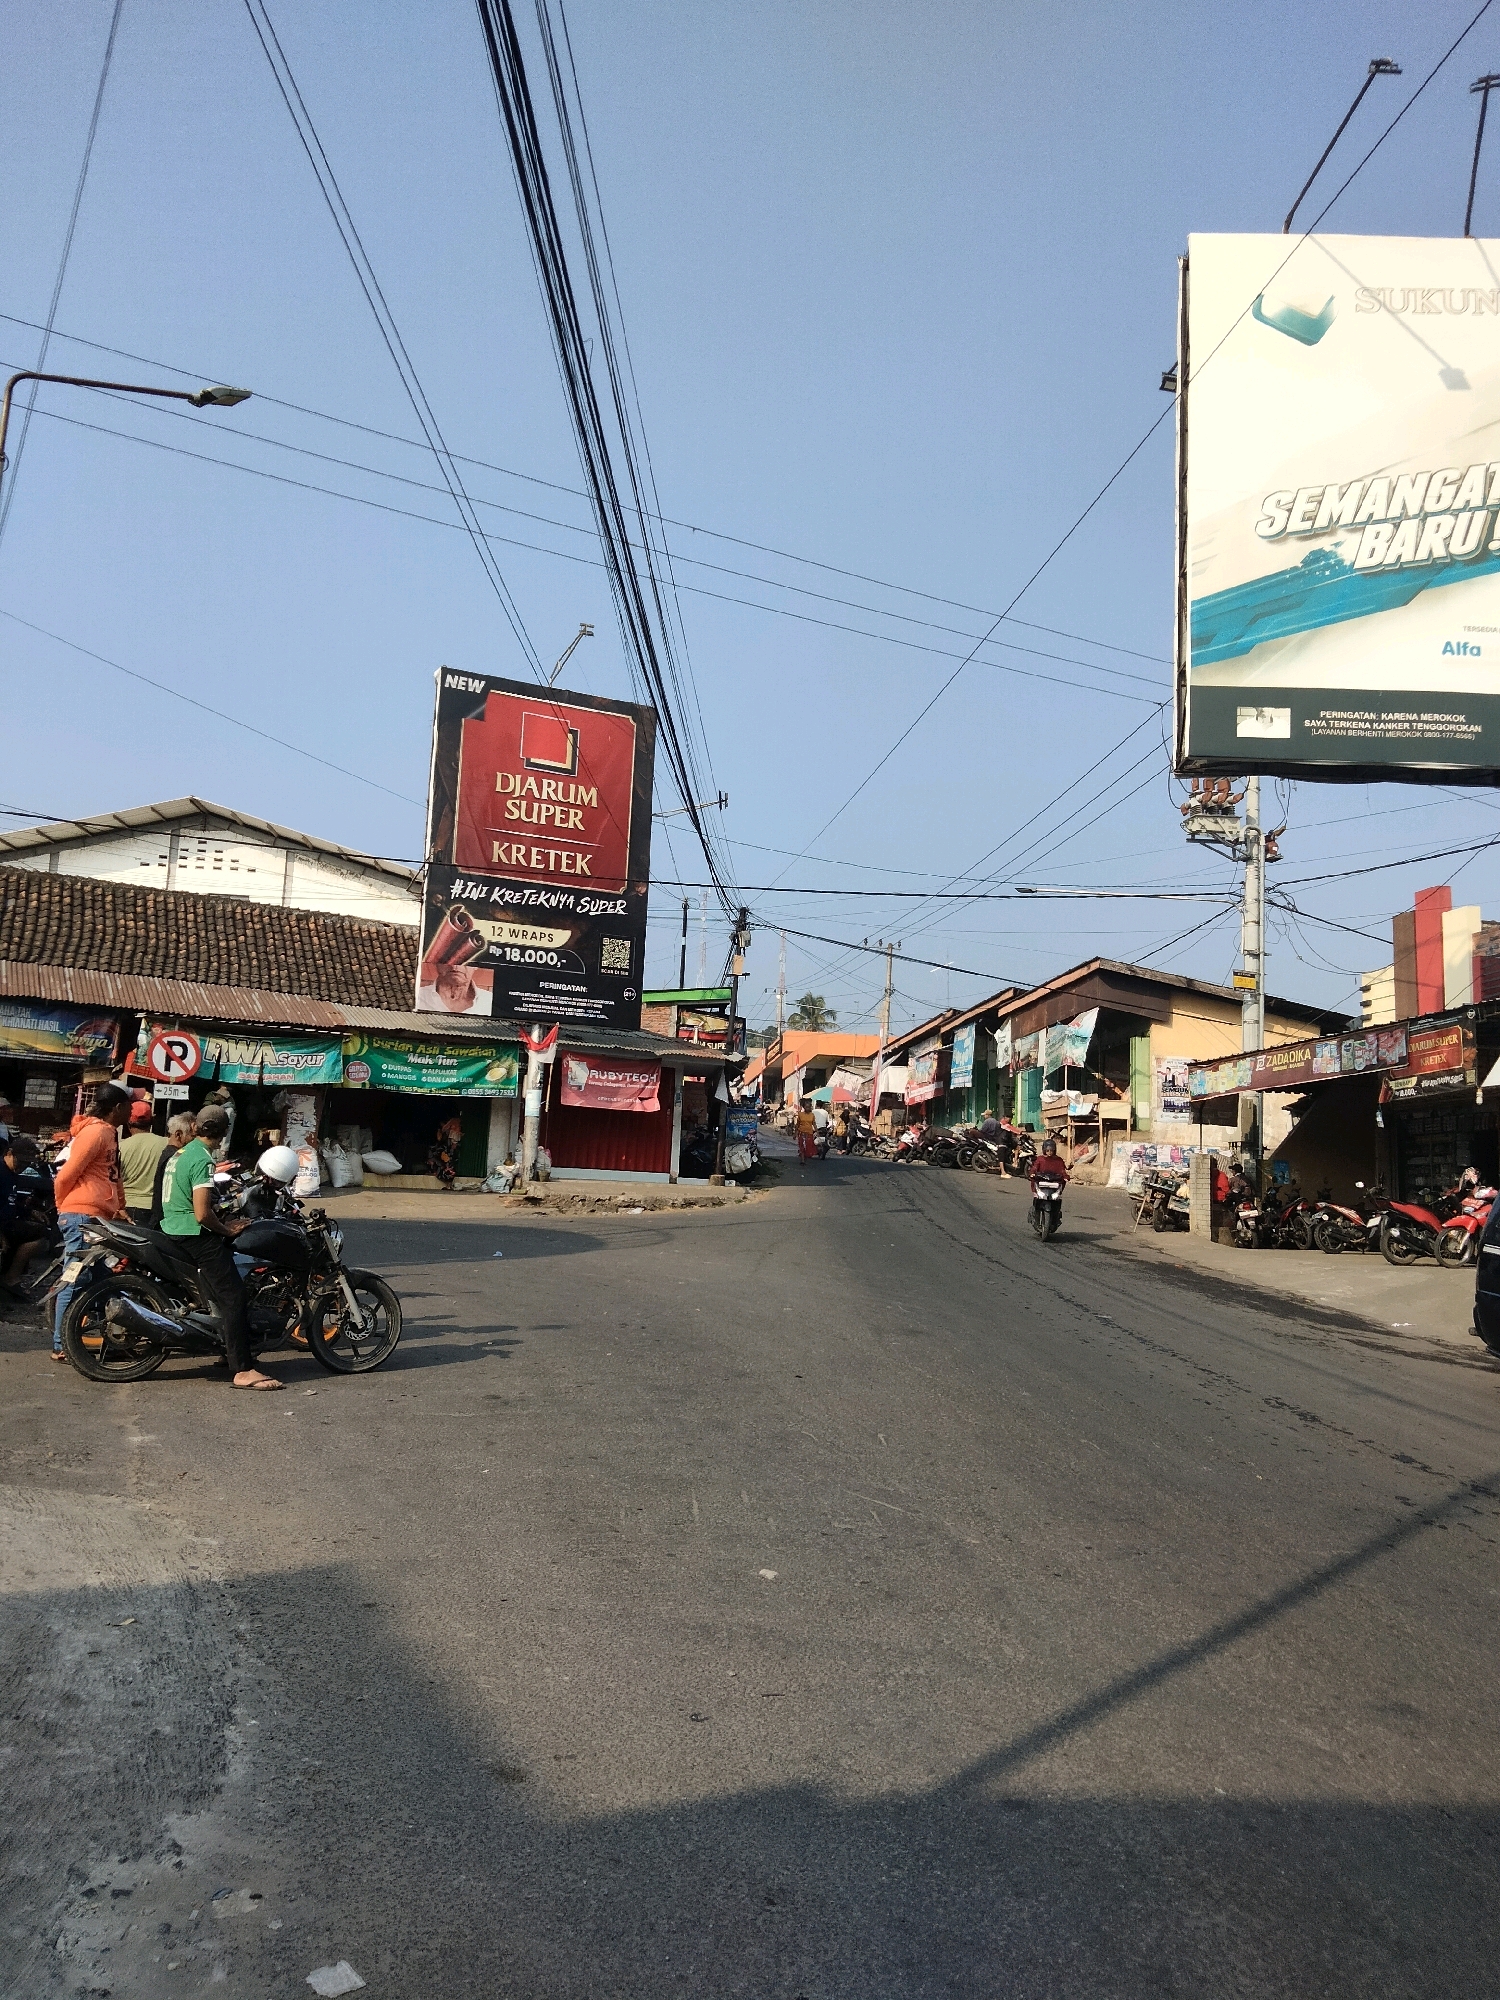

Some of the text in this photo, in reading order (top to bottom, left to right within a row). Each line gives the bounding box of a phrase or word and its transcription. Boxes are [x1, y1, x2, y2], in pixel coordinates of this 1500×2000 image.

[1355, 286, 1500, 316] SUKUN
[1441, 640, 1482, 657] Alfa
[444, 673, 487, 694] NEW
[1304, 719, 1482, 733] SAYA TERKENA KANKER TENGGOROKAN
[1381, 711, 1419, 721] KARENA
[1420, 712, 1466, 723] MEROKOK
[1347, 729, 1385, 738] BERHENTI
[1385, 730, 1423, 739] MEROKOK
[494, 771, 599, 808] DJARUM
[504, 799, 586, 831] SUPER
[491, 840, 593, 876] KRETEK
[576, 896, 629, 916] SUPER
[491, 925, 555, 943] 12 WRAPS
[489, 945, 503, 957] Rp
[277, 1051, 326, 1069] Sayur
[589, 1069, 657, 1083] RUBYTECH
